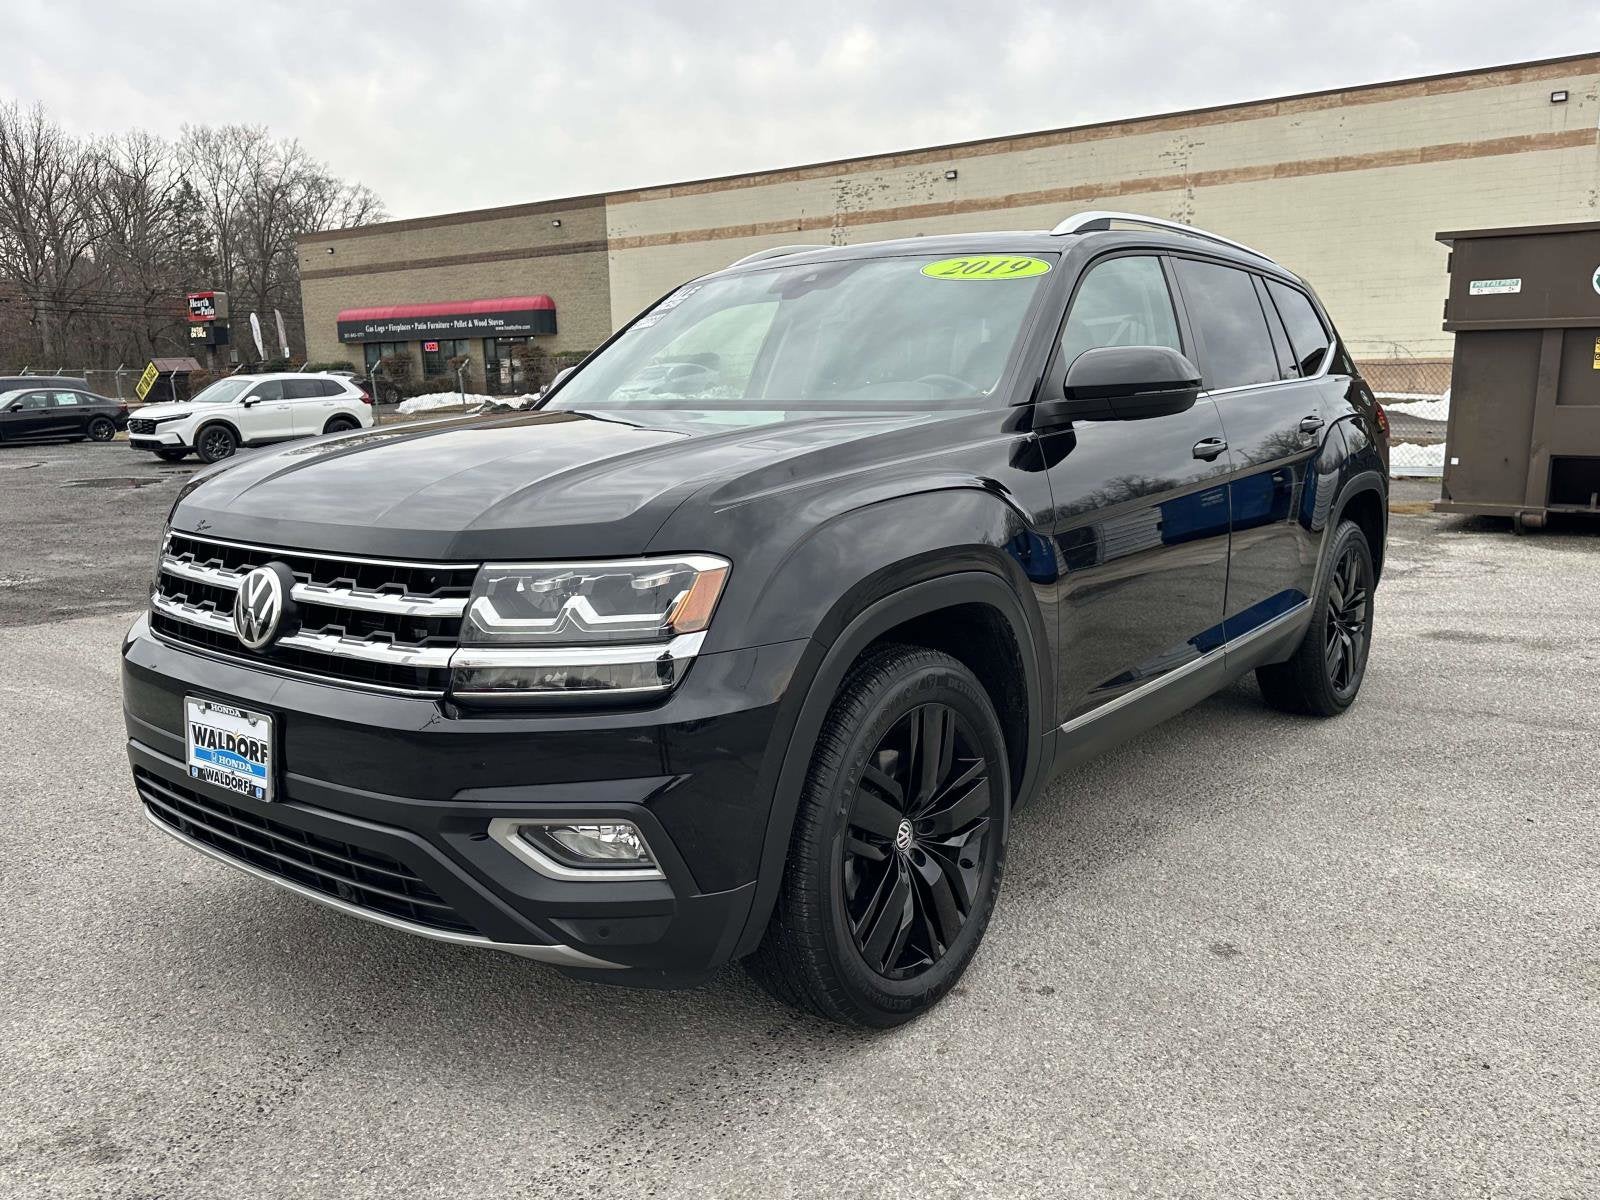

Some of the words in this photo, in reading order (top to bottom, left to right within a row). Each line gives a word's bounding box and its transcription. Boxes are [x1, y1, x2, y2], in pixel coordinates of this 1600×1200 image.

[938, 260, 1032, 275] 2019
[190, 298, 209, 307] Hearth
[201, 306, 214, 315] Patio
[374, 325, 385, 333] Logs
[388, 323, 411, 333] Fireplaces
[414, 322, 427, 330] Patio
[427, 321, 450, 329] Furniture
[454, 320, 467, 328] Pellet
[473, 319, 487, 327] Wood
[488, 318, 504, 326] Stoves
[211, 703, 241, 718] HONDA
[192, 724, 268, 764] WALDORF
[219, 755, 253, 772] HONDA
[204, 767, 250, 793] WALDORF
